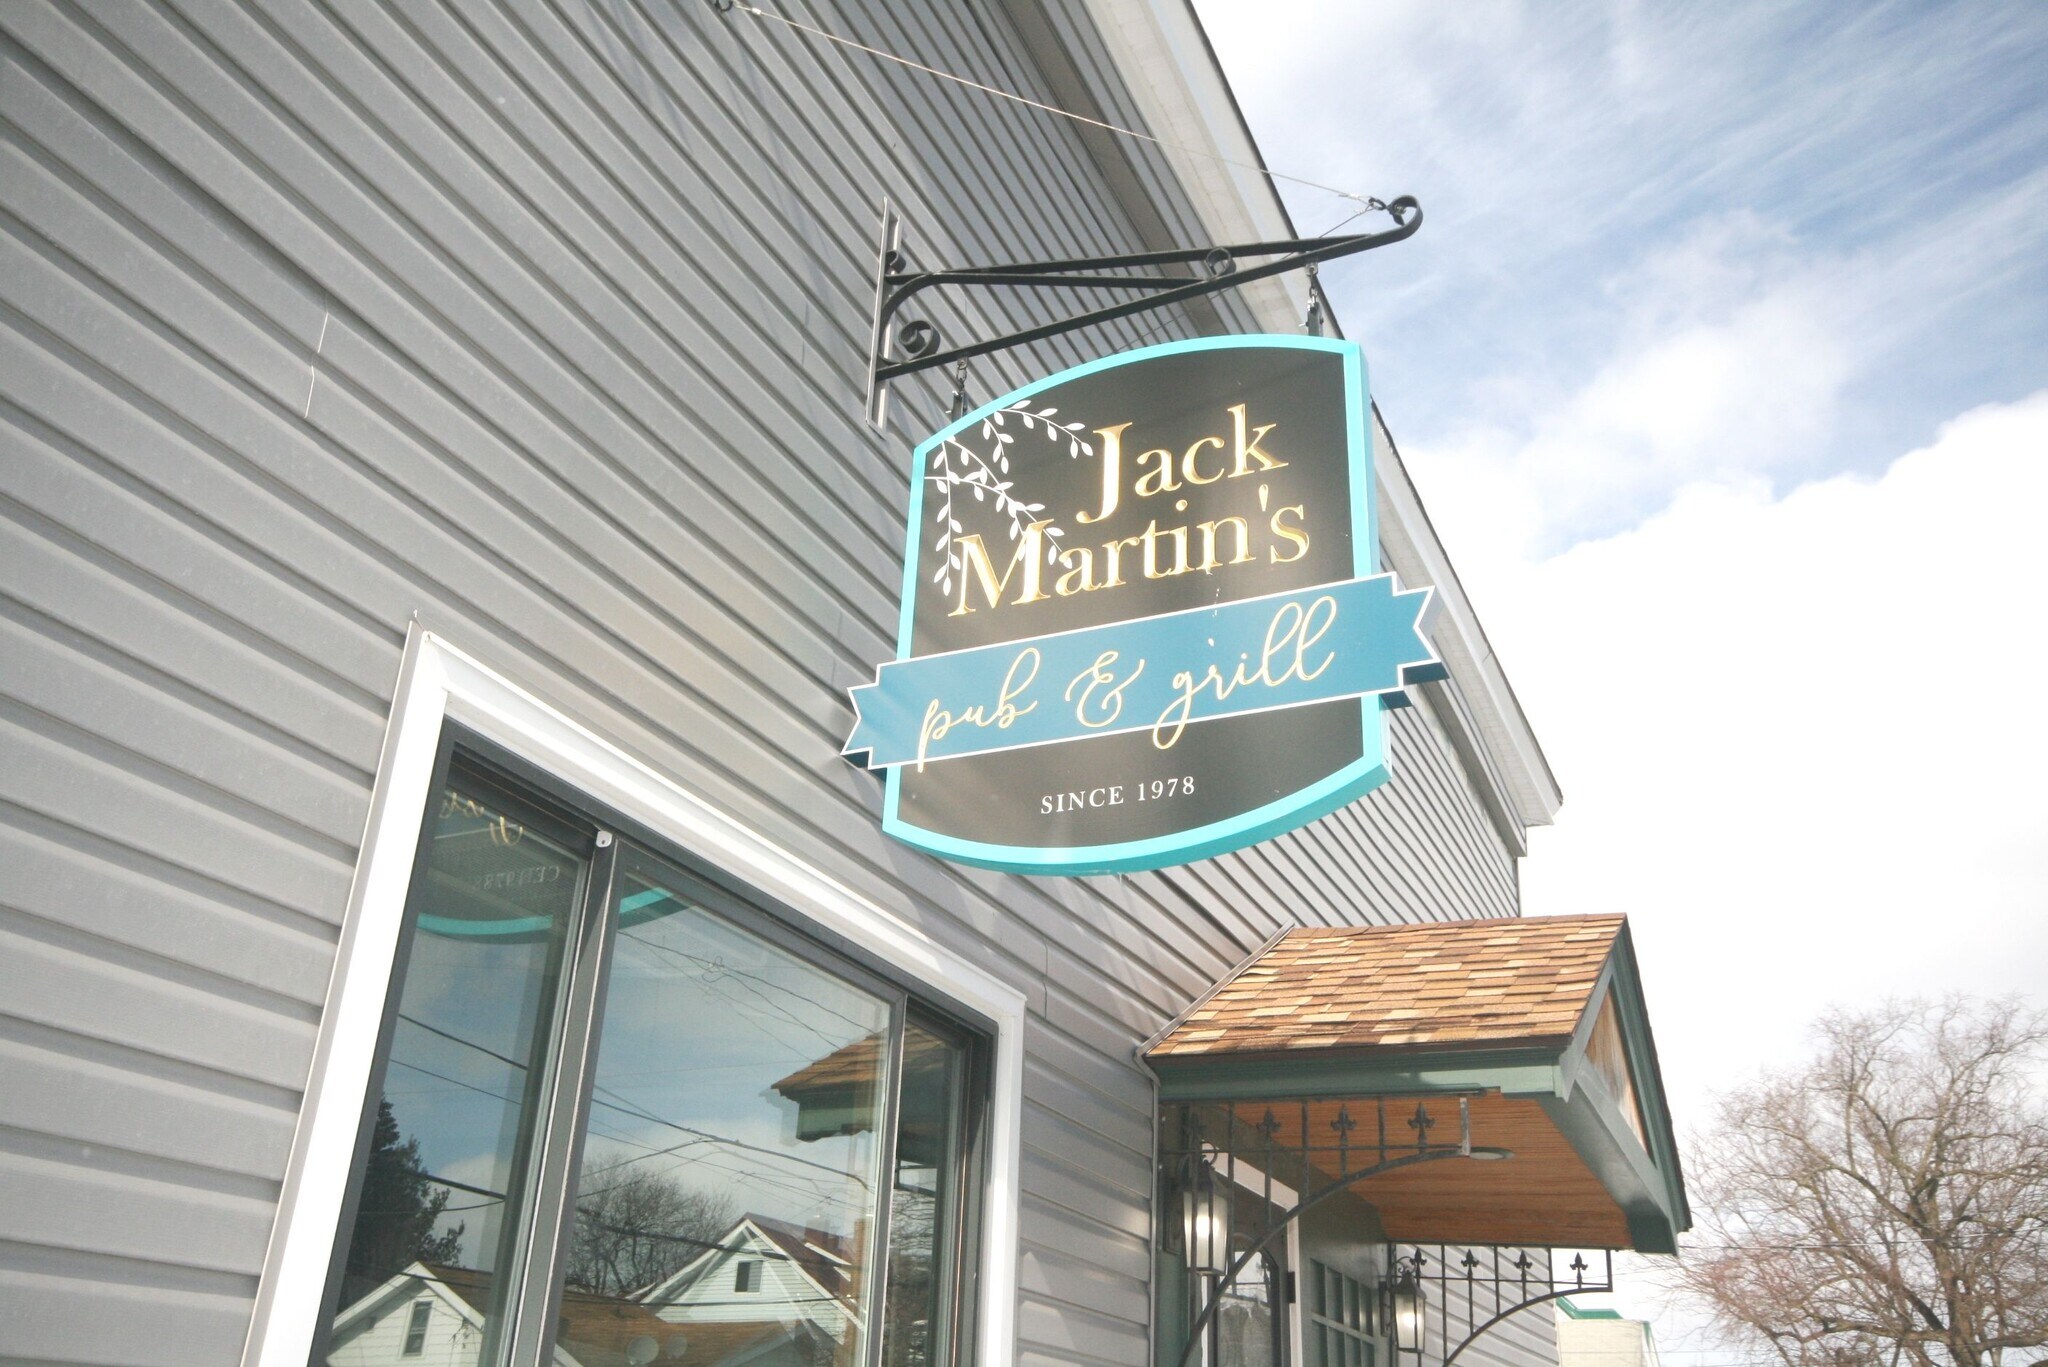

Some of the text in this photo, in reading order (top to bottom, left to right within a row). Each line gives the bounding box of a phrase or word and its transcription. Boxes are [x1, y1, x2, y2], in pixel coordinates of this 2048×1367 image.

[1075, 403, 1289, 524] Jack
[948, 484, 1310, 617] Martin's
[918, 595, 1338, 773] pub & grill
[1040, 775, 1196, 815] SINCE 1978
